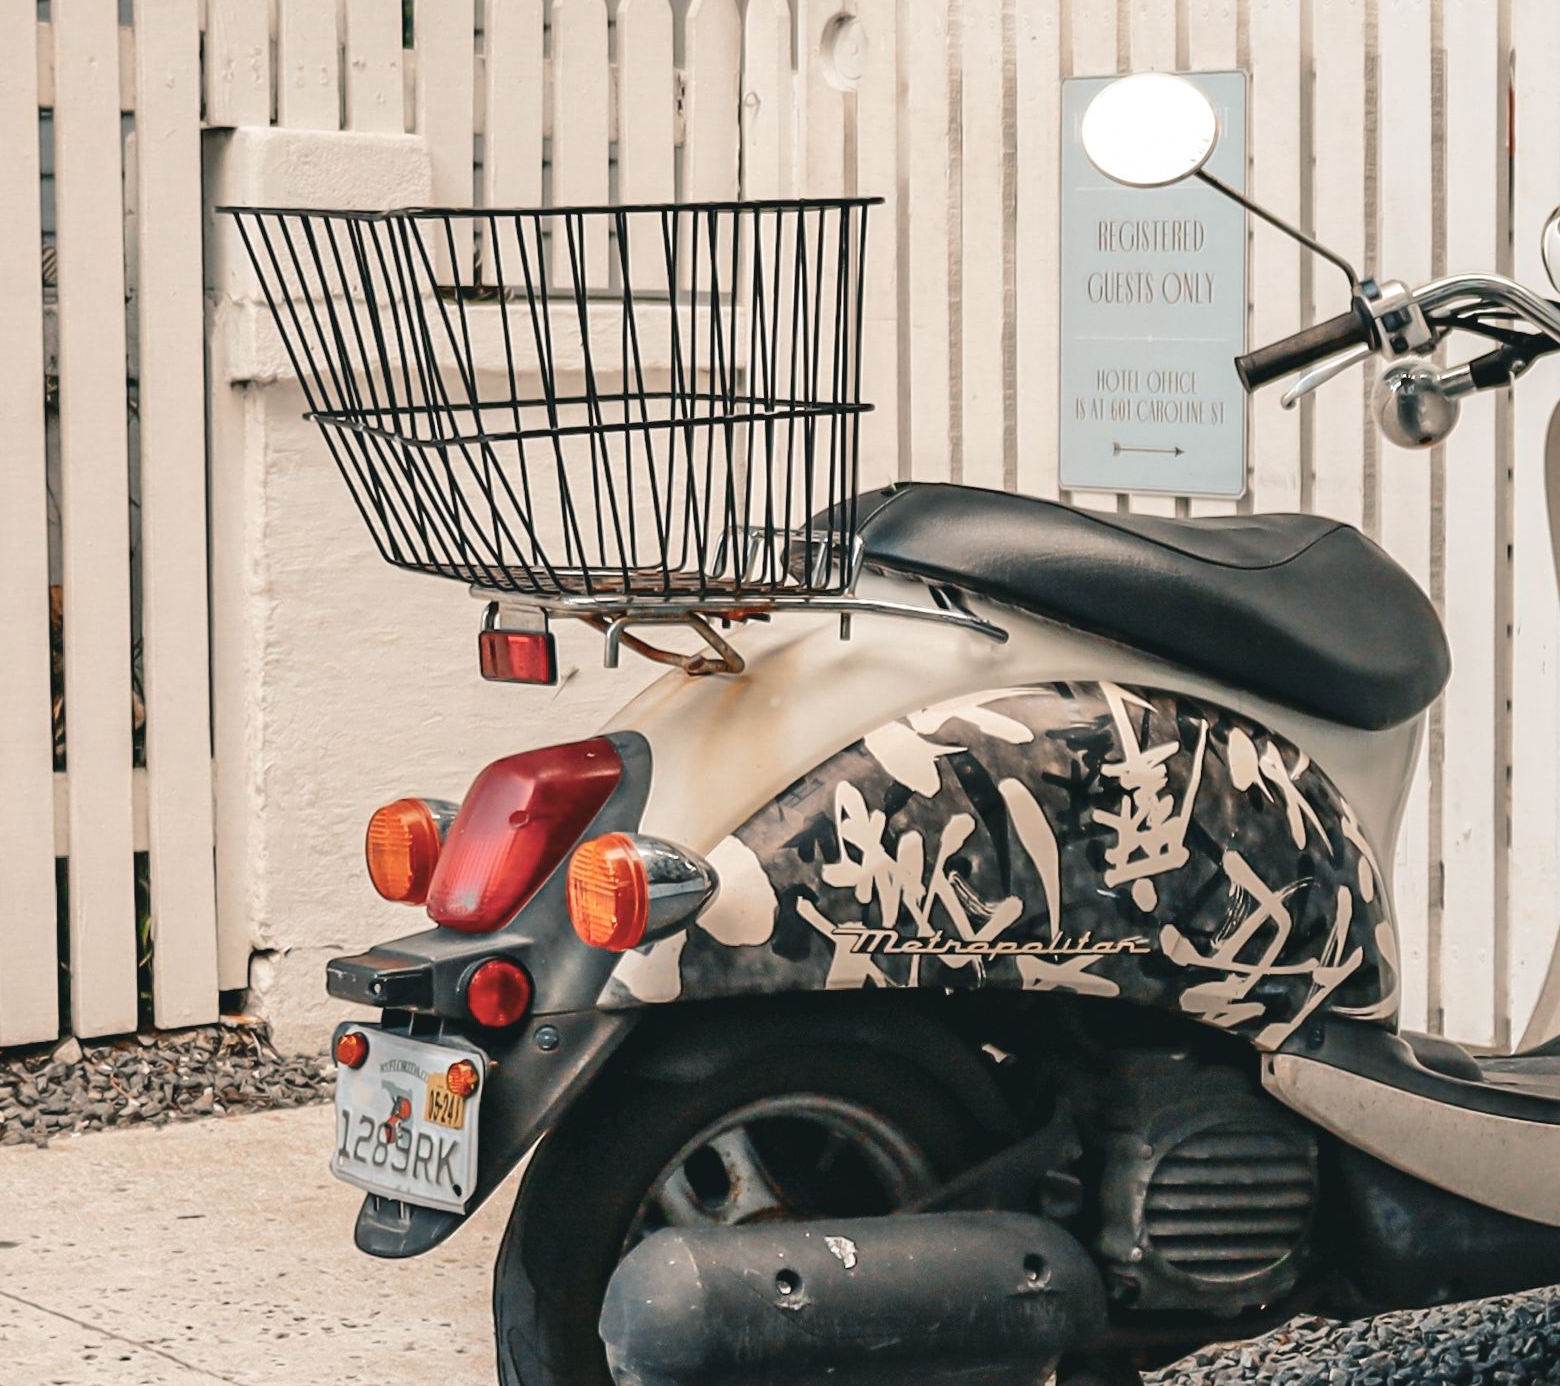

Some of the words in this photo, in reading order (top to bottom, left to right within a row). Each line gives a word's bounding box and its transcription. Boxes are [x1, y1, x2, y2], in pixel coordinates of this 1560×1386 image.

[1097, 219, 1205, 252] REGISTERED
[1087, 271, 1155, 304] GUESTS
[1161, 271, 1216, 305] ONLY
[1096, 368, 1140, 394] HOTEL
[1146, 369, 1198, 395] OFFICE
[1075, 396, 1086, 421] IS
[1092, 397, 1105, 421] AT
[1110, 398, 1132, 422] 601
[1136, 398, 1205, 425] CAROLINE
[1211, 400, 1225, 426] ST
[831, 929, 1152, 961] Metropolitan
[339, 1109, 461, 1188] 1289RK
